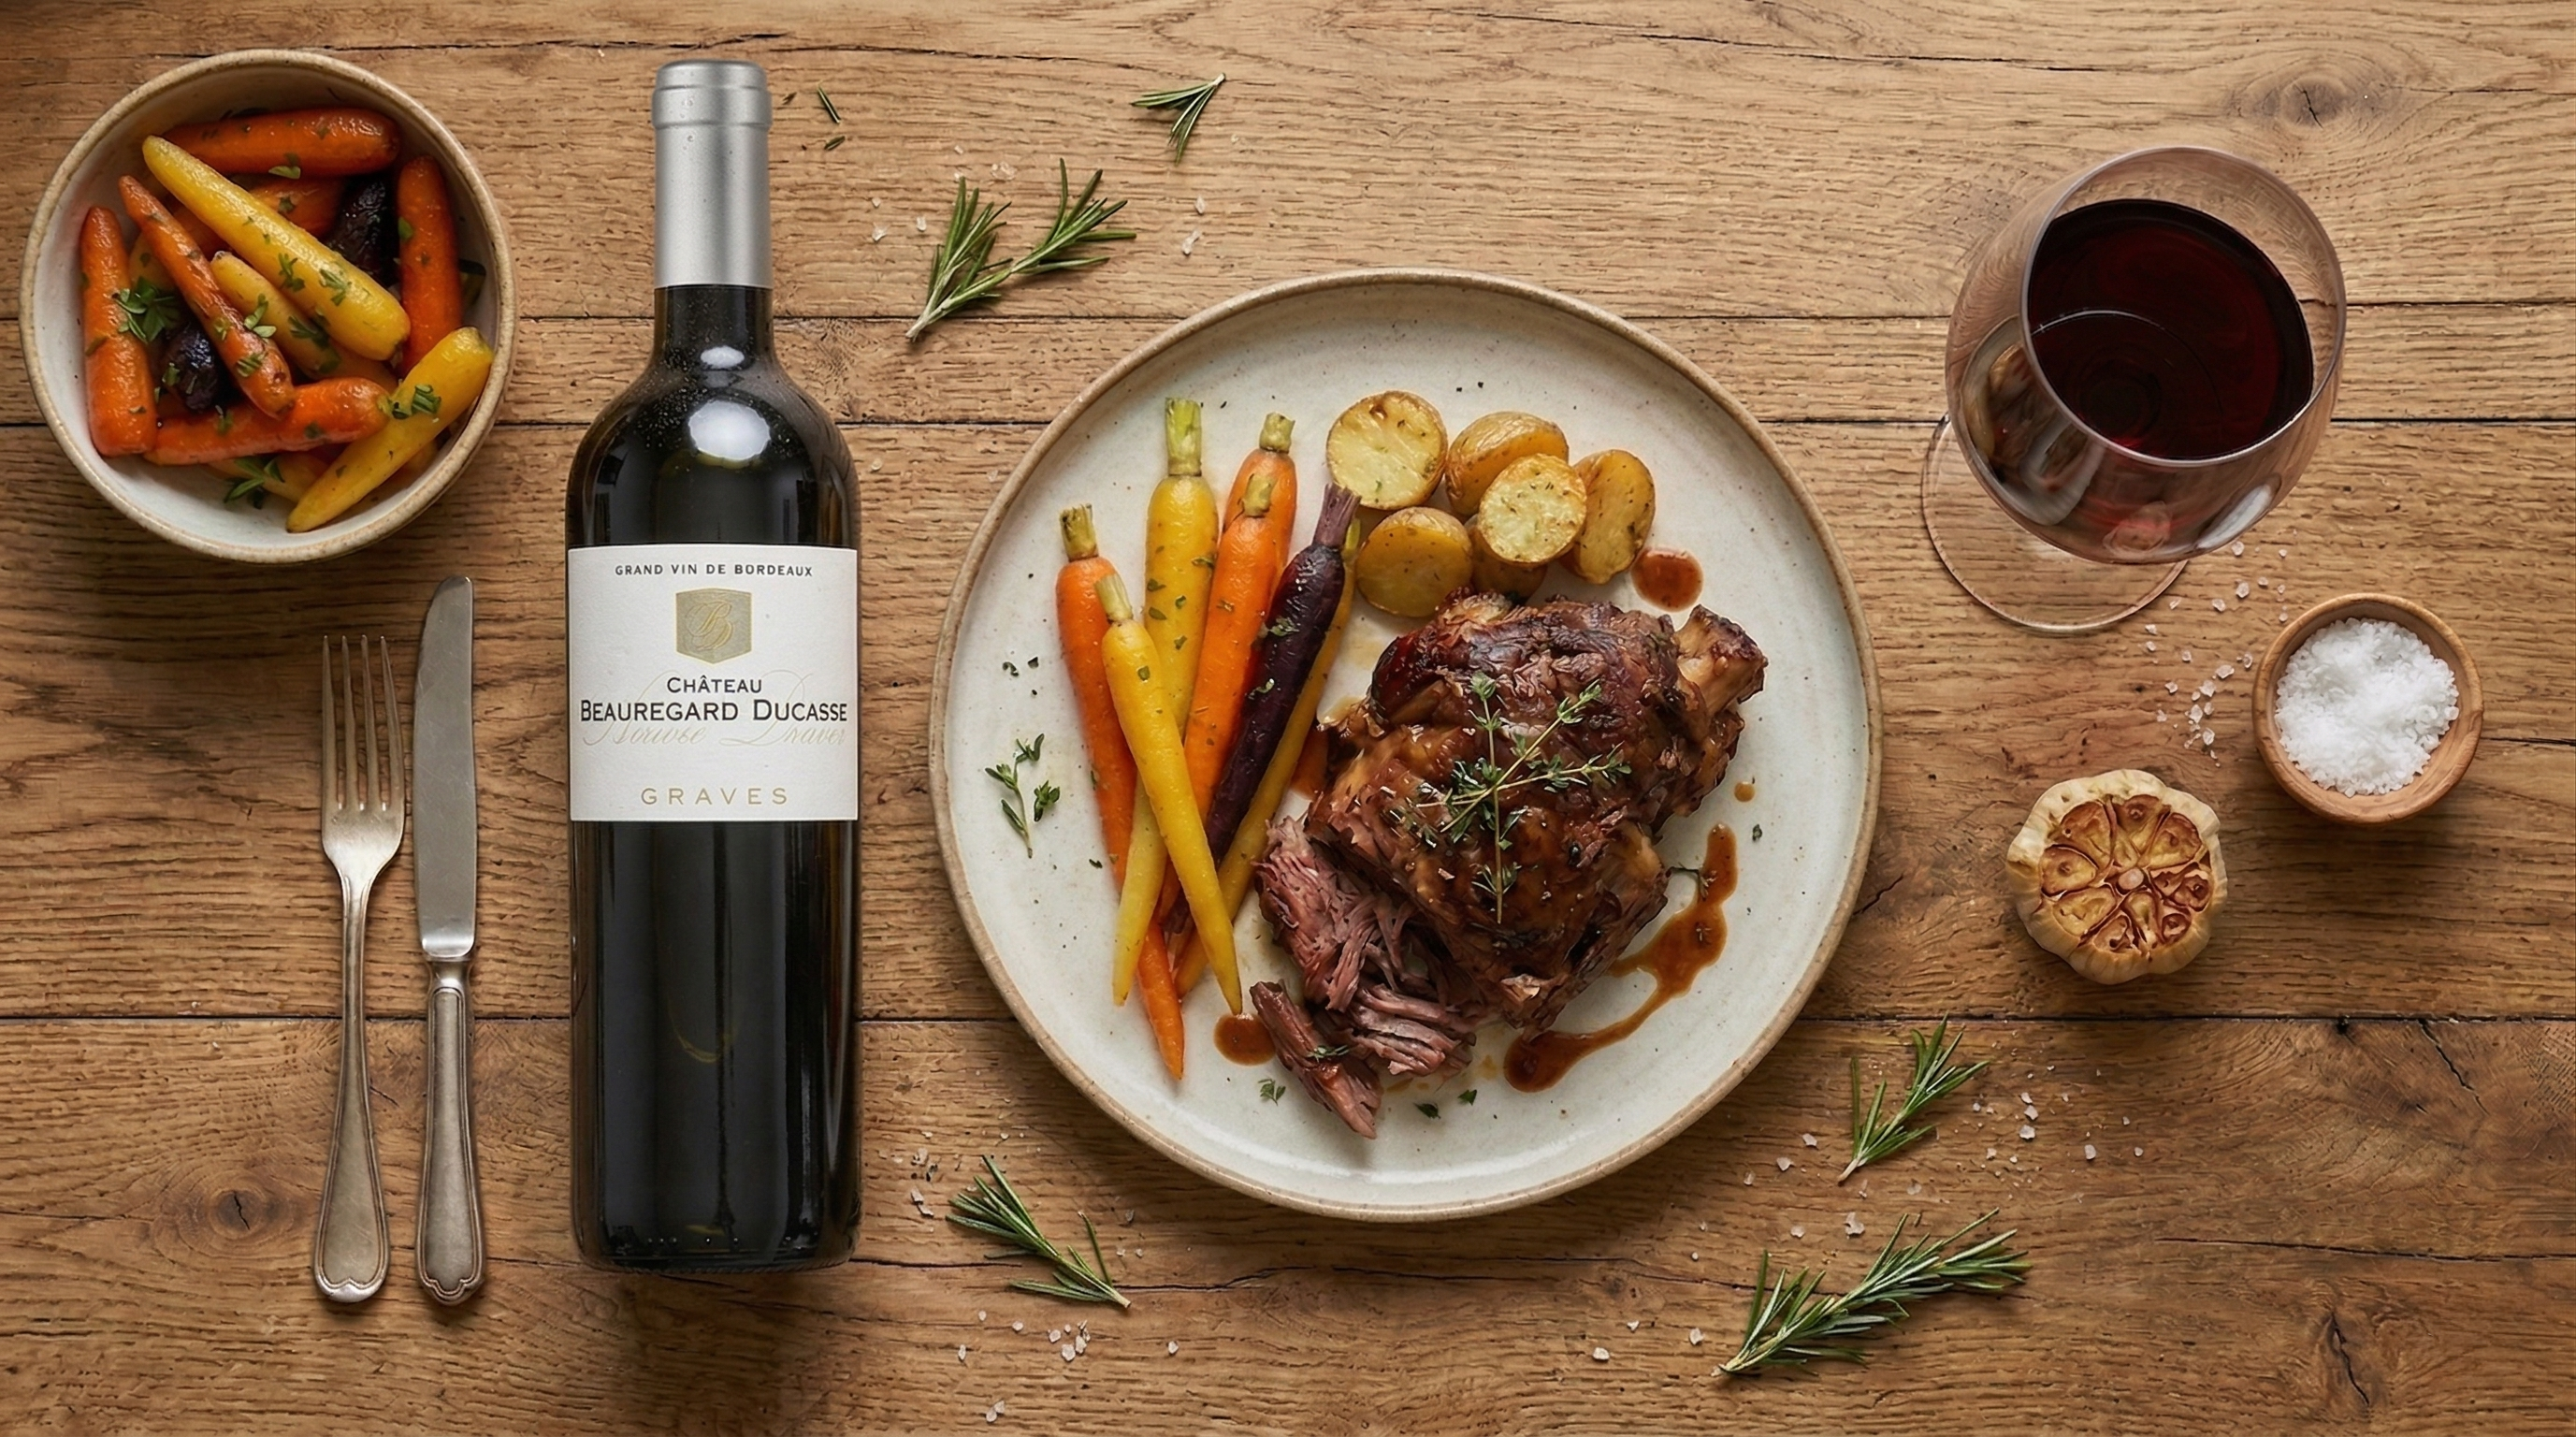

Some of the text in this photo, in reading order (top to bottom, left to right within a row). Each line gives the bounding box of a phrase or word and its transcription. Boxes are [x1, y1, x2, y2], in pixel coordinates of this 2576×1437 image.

[615, 563, 813, 577] GRAND VIN DE BORDEAUX
[666, 675, 763, 694] CHÂTEAU
[580, 699, 847, 722] BEAUREGARD DUCASSE
[641, 788, 788, 806] GRAVES
